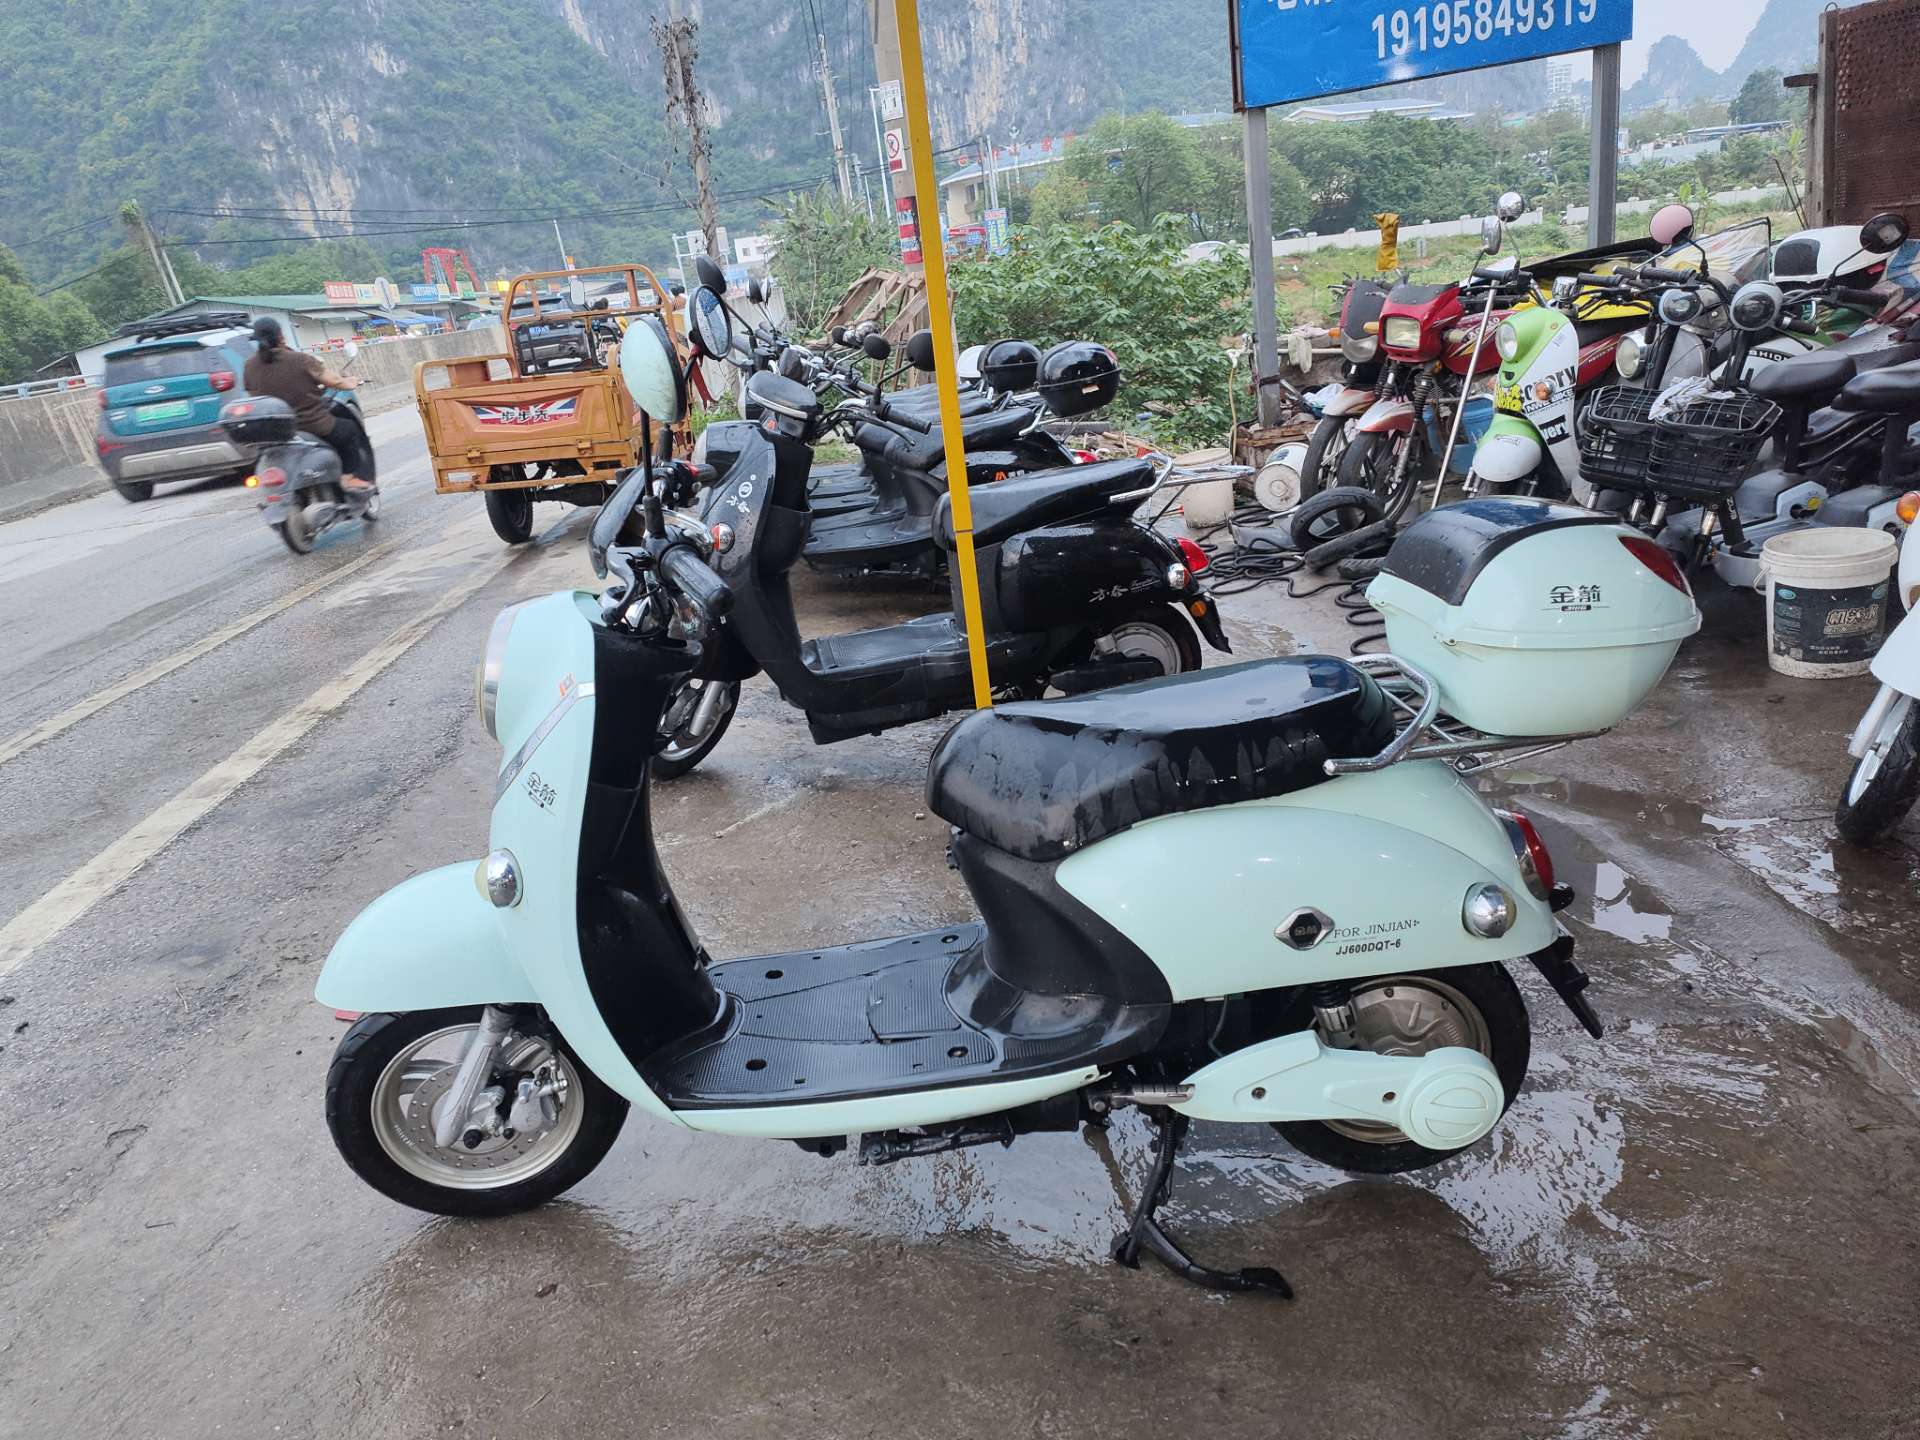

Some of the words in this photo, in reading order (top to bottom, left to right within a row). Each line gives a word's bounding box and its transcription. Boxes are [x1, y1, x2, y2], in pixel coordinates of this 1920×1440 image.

[1371, 0, 1597, 58] 19195849319
[1334, 926, 1360, 939] FOR
[1365, 919, 1412, 936] JINJIAN
[1336, 938, 1401, 956] JJ600DQT-6
